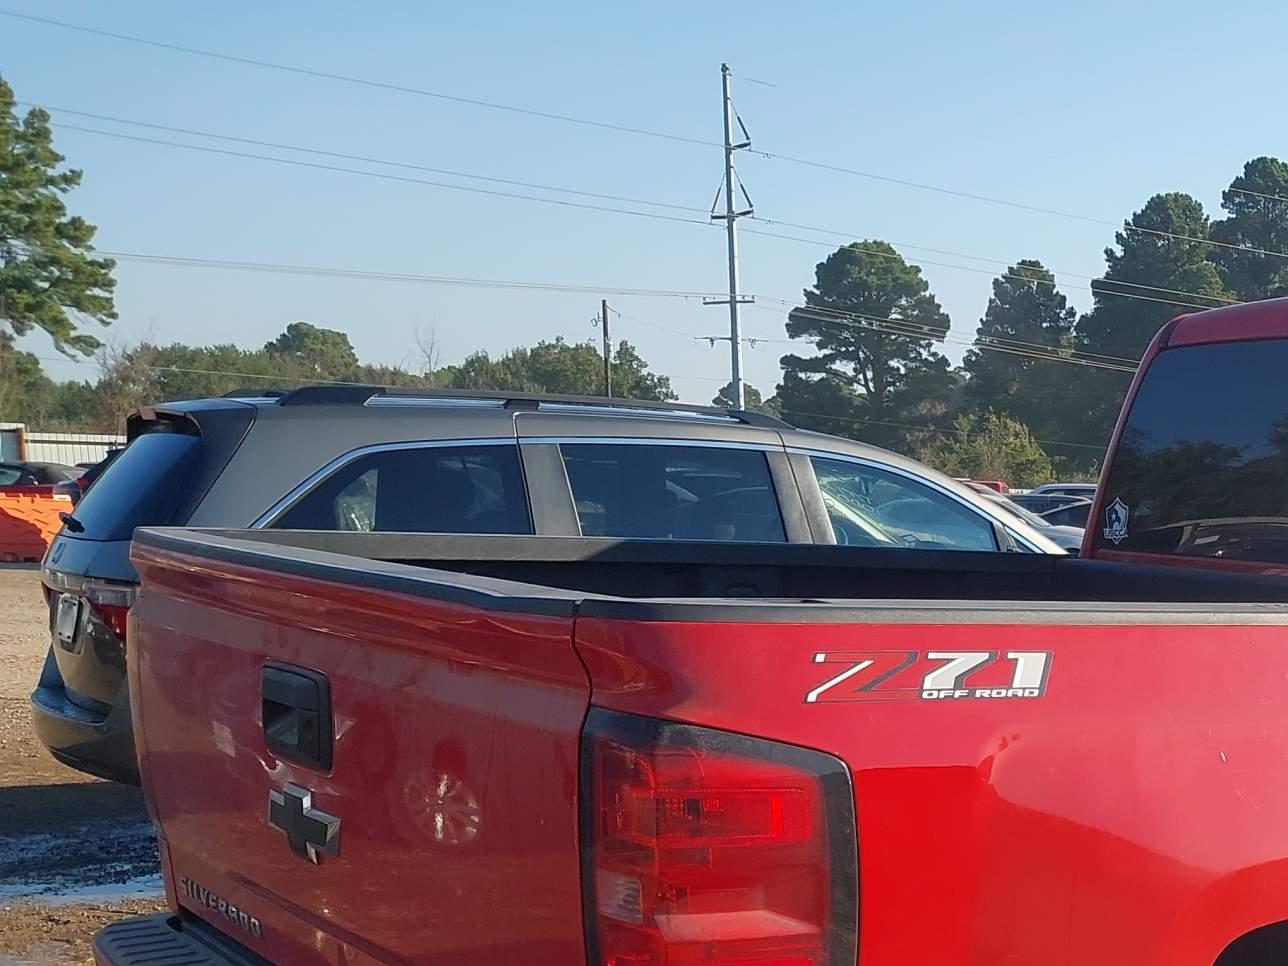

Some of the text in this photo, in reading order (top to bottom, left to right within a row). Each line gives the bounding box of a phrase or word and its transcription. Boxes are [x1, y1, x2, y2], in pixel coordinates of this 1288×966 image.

[922, 688, 1040, 699] OFF ROAD
[180, 878, 262, 937] SILVERADO
